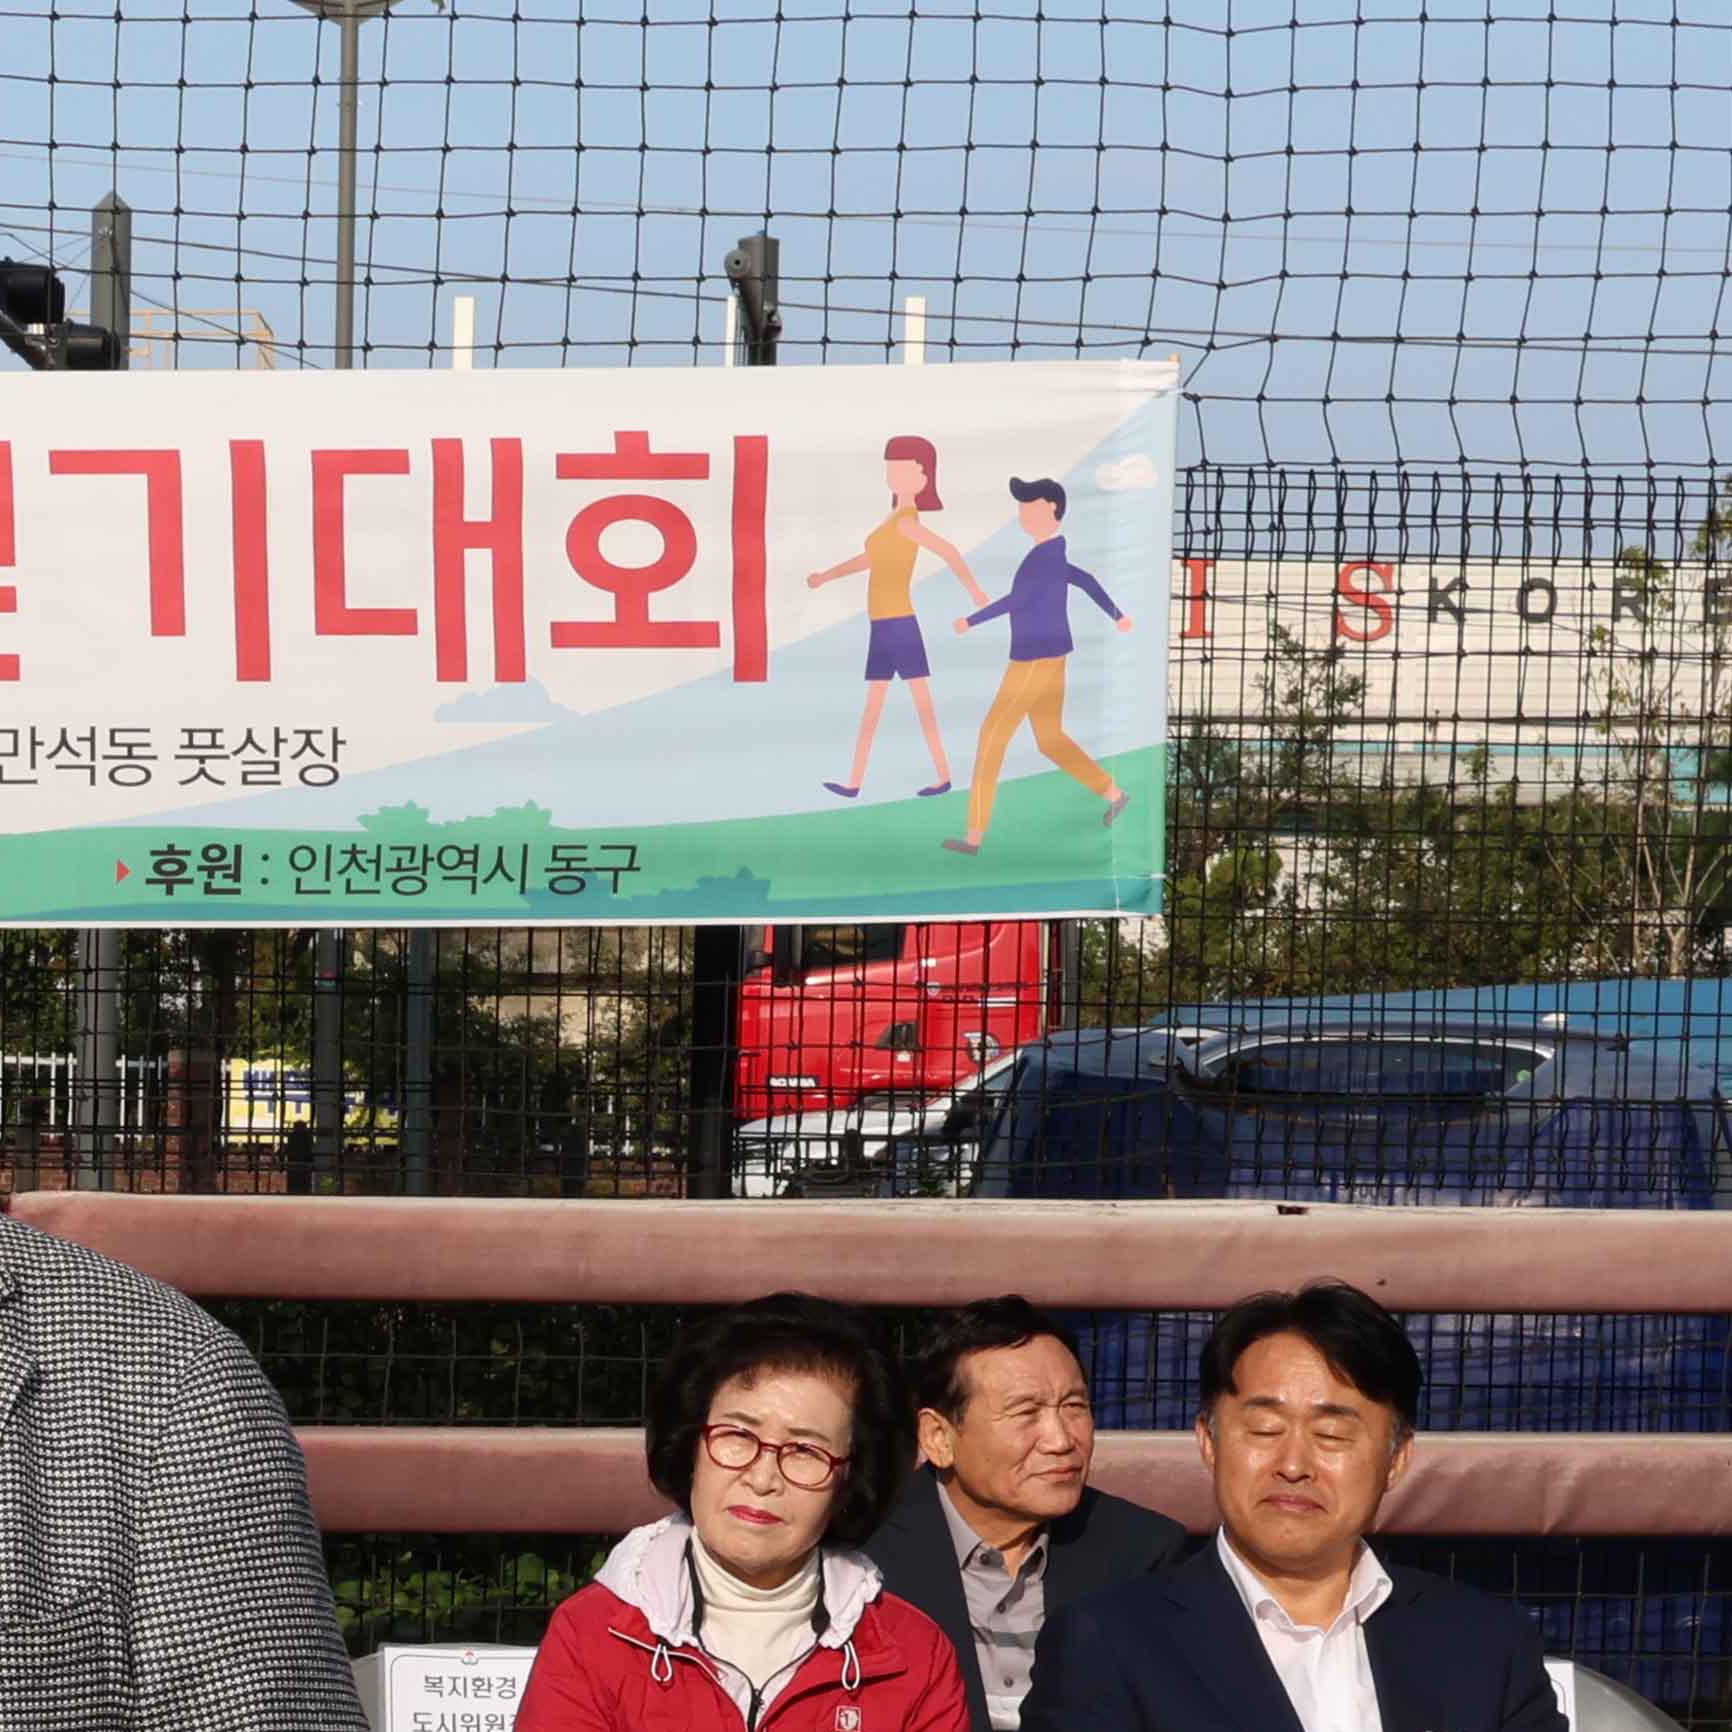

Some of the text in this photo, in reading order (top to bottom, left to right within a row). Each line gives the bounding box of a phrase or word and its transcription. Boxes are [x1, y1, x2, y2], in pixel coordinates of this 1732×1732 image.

[174, 726, 347, 788] 풋살장
[145, 843, 243, 896] 후원
[288, 843, 529, 896] 인천광역시
[544, 844, 641, 896] 동구
[423, 1674, 517, 1701] 복지환경
